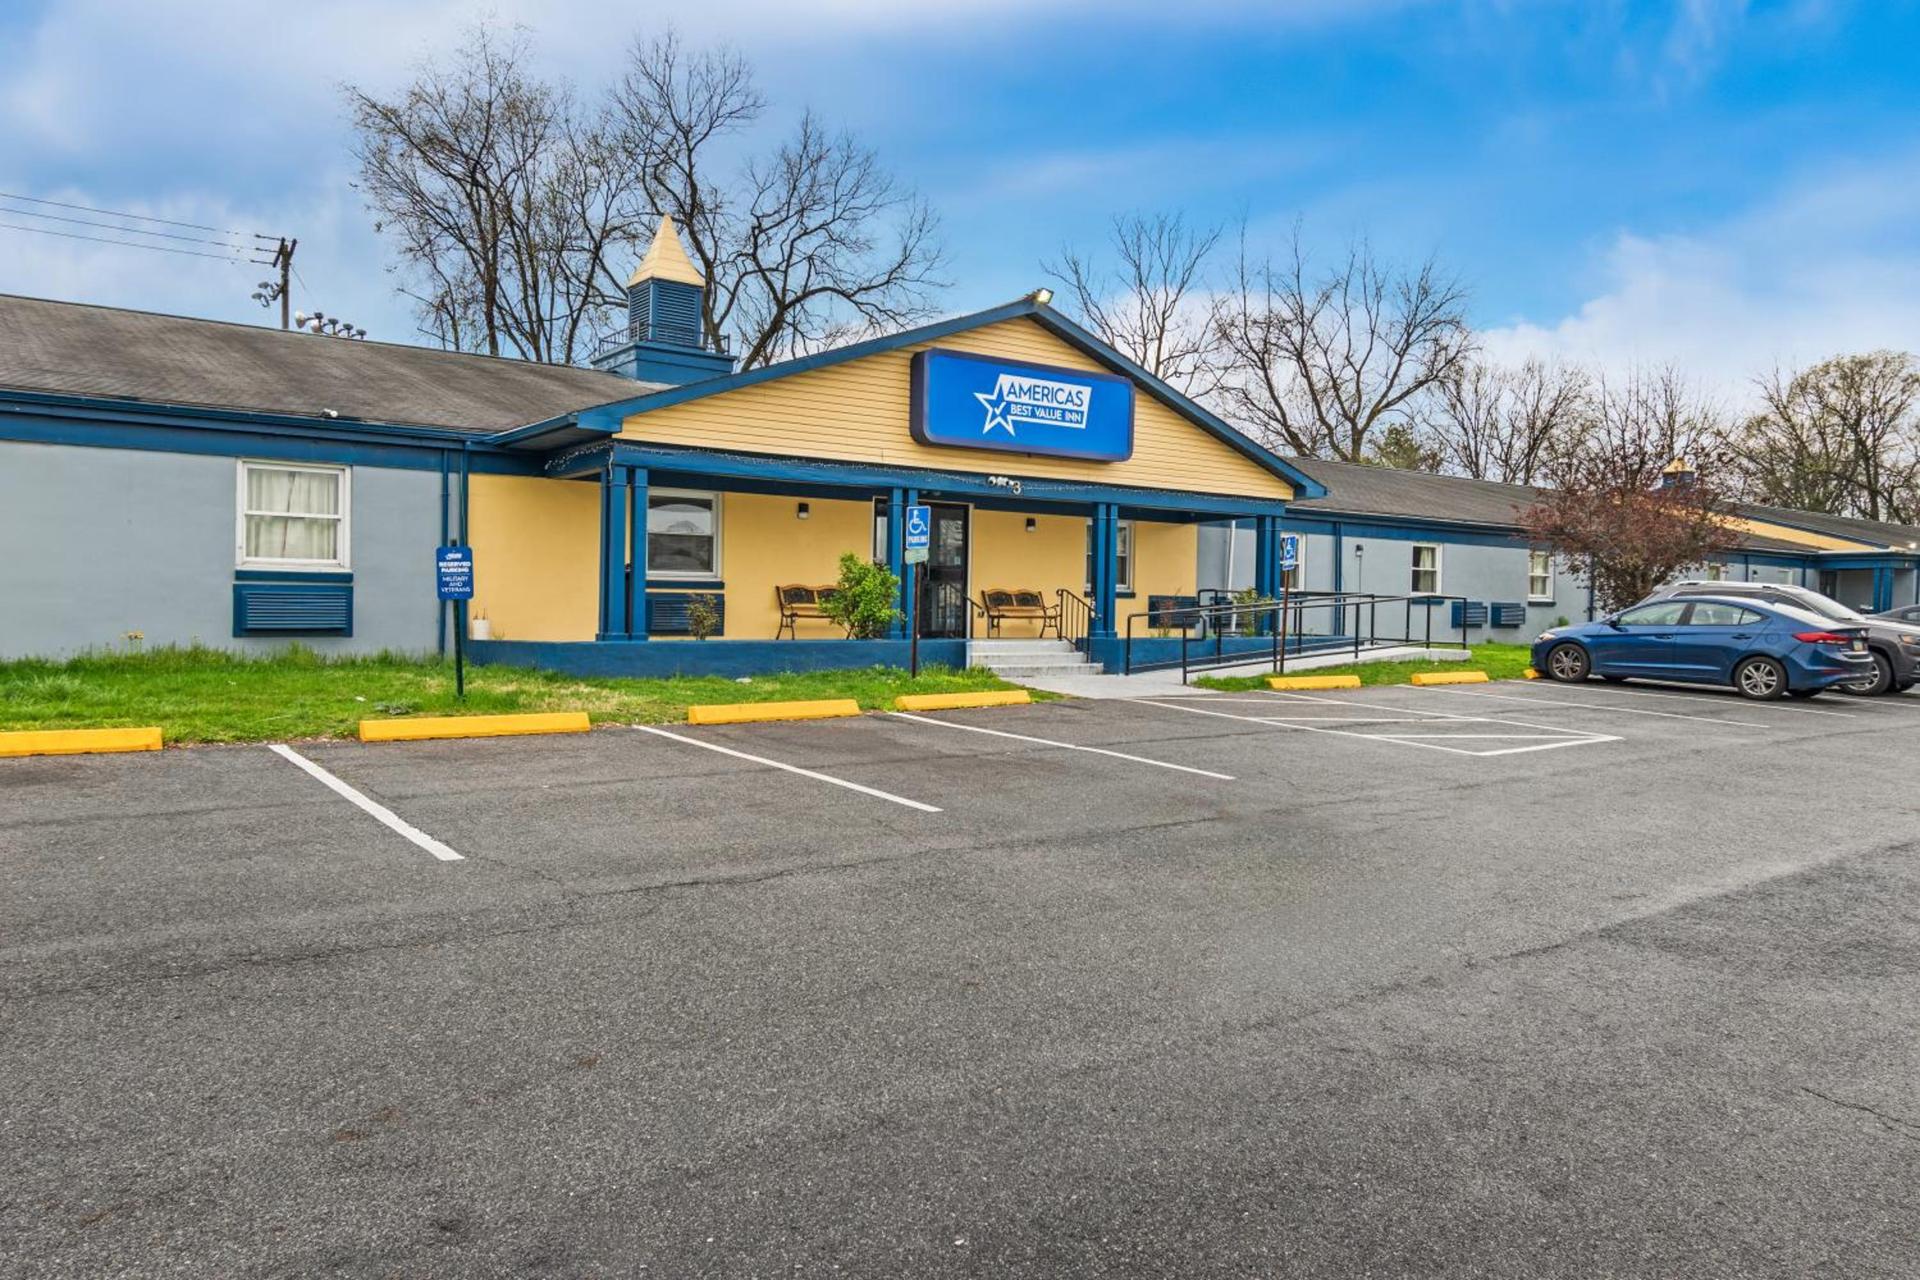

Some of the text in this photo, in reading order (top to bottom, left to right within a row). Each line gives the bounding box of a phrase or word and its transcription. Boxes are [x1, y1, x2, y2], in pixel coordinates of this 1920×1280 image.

[1006, 381, 1084, 408] AMERICAS
[1010, 405, 1082, 423] BEST VALUE INN
